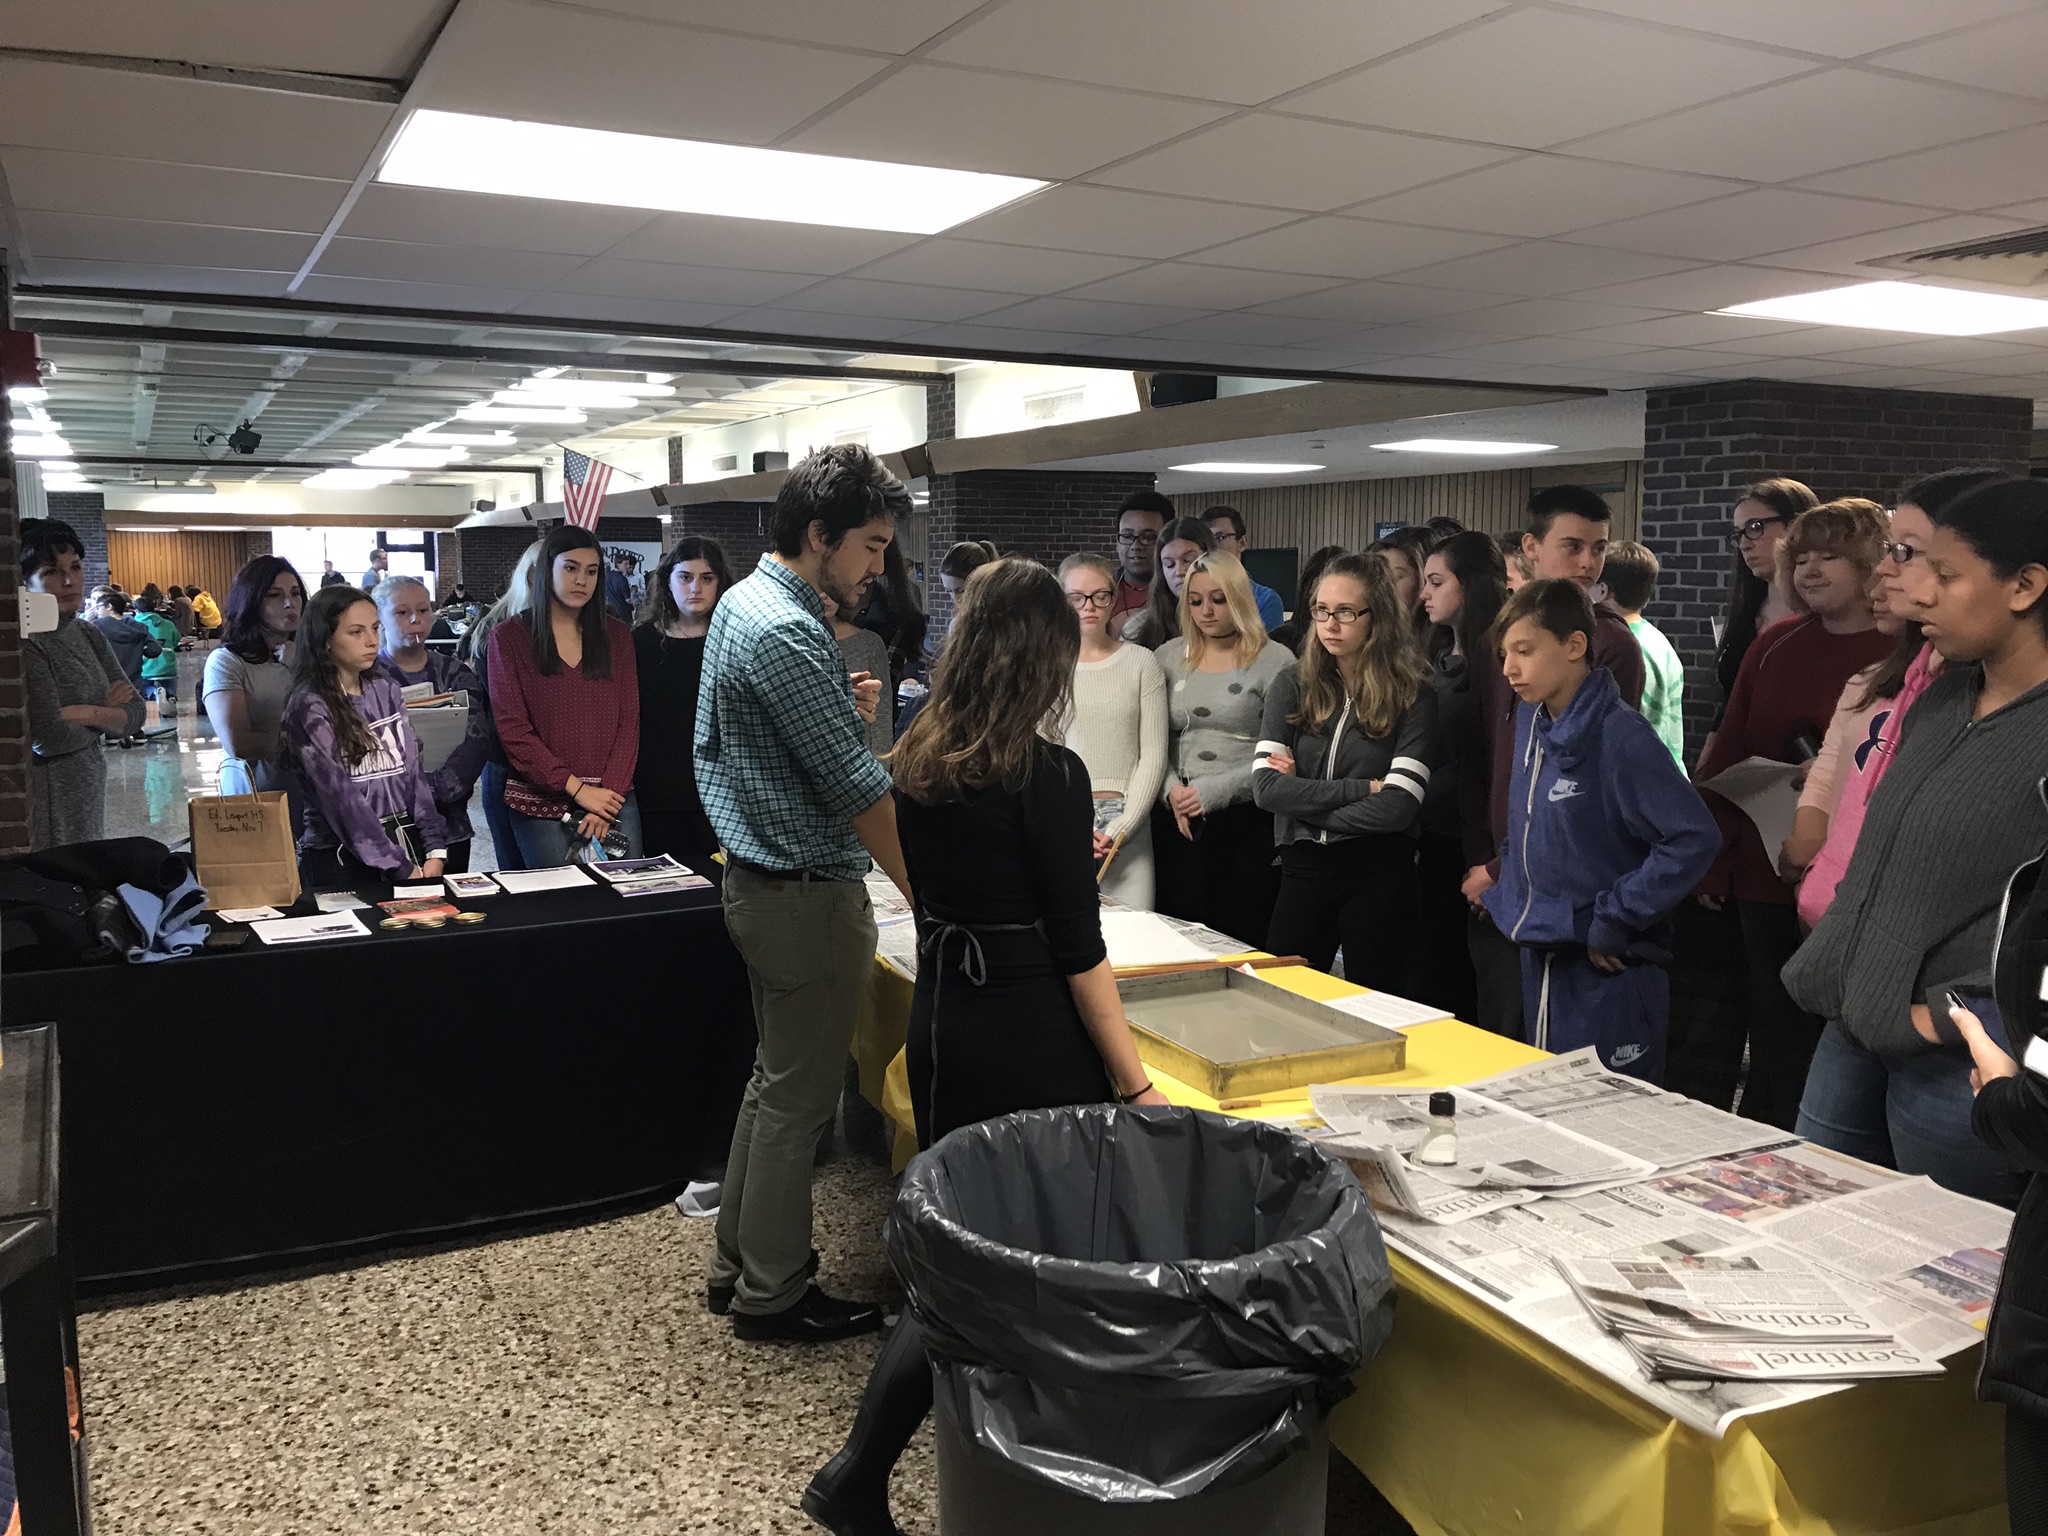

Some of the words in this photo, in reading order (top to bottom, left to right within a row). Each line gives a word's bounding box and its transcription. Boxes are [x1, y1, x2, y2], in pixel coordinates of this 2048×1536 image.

[1616, 1043, 1641, 1059] NIKE
[1713, 1310, 1871, 1330] Sentinel
[1755, 1349, 1921, 1371] Sentinel
